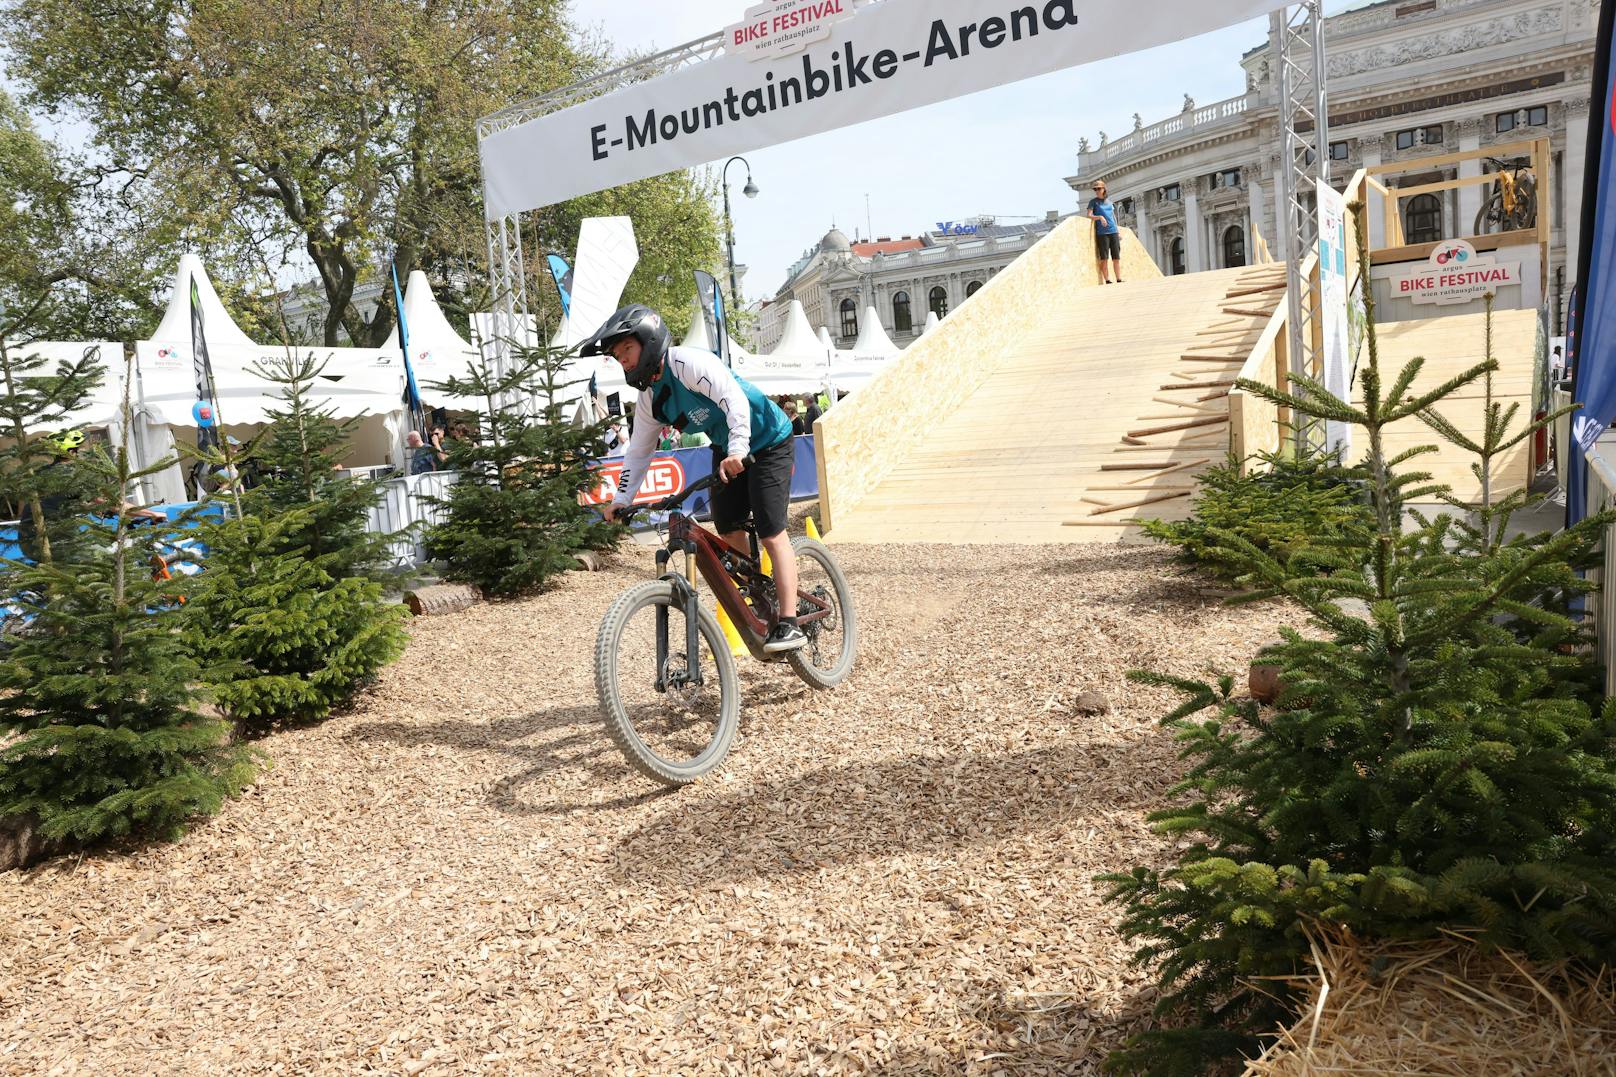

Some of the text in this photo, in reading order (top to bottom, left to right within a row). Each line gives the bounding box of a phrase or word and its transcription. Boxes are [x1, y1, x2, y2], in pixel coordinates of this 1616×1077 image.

[775, 1, 796, 12] argus
[734, 0, 844, 46] BIKE FESTIVAL
[755, 24, 821, 50] wien rathausplatz
[590, 0, 1078, 161] E-Mountainbike-Arena
[1400, 268, 1510, 292] BIKE FESTIVAL
[1442, 264, 1463, 273] argus
[1421, 285, 1487, 298] wien rathausplatz
[260, 356, 309, 366] GRANL
[600, 467, 673, 501] AUS
